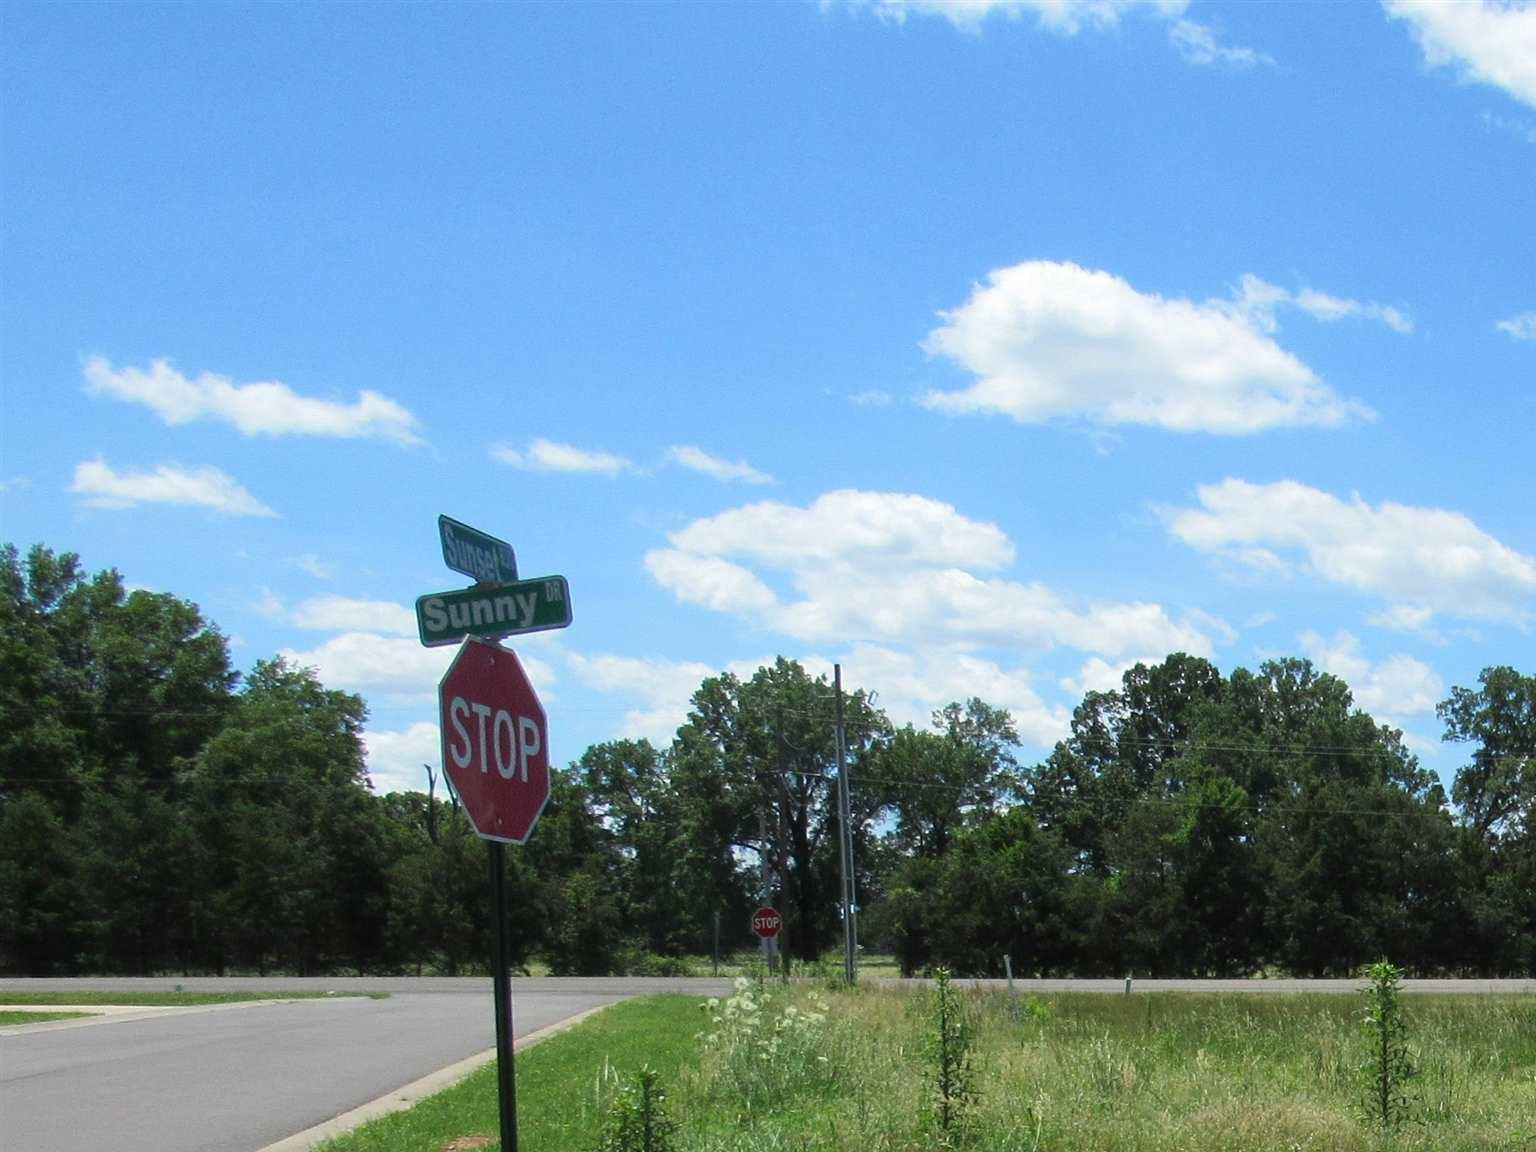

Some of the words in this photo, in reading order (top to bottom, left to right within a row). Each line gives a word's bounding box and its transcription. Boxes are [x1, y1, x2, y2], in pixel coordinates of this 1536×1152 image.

[423, 592, 538, 633] Sunny
[545, 580, 563, 602] DR
[450, 696, 541, 783] STOP
[755, 917, 779, 930] STOP
